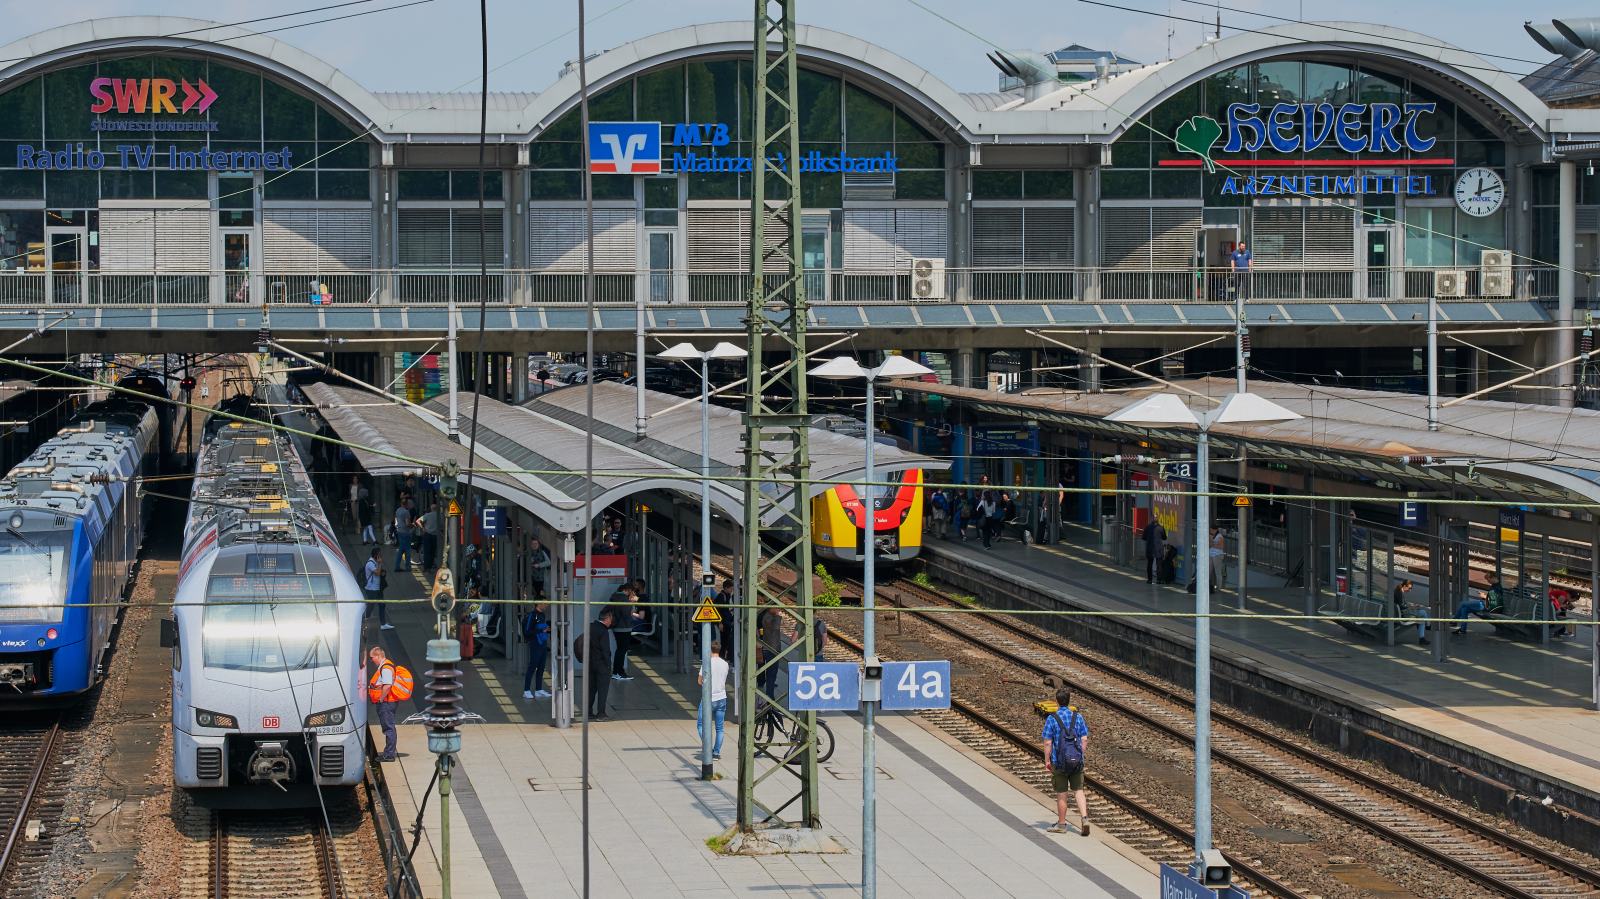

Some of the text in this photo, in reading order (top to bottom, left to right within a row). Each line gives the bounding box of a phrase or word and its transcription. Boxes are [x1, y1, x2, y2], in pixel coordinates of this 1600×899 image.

[89, 77, 179, 114] SWR
[90, 118, 219, 132] SÜDWESTRUNDFUNK
[672, 122, 730, 147] MVB
[16, 142, 294, 171] Radio TV Internet
[1220, 174, 1437, 195] ARZNEIMITTEL
[482, 508, 496, 530] E
[1403, 502, 1417, 520] E
[2, 639, 29, 647] vlexx
[795, 664, 841, 701] 5a
[897, 662, 944, 699] 4a
[264, 718, 278, 727] DB
